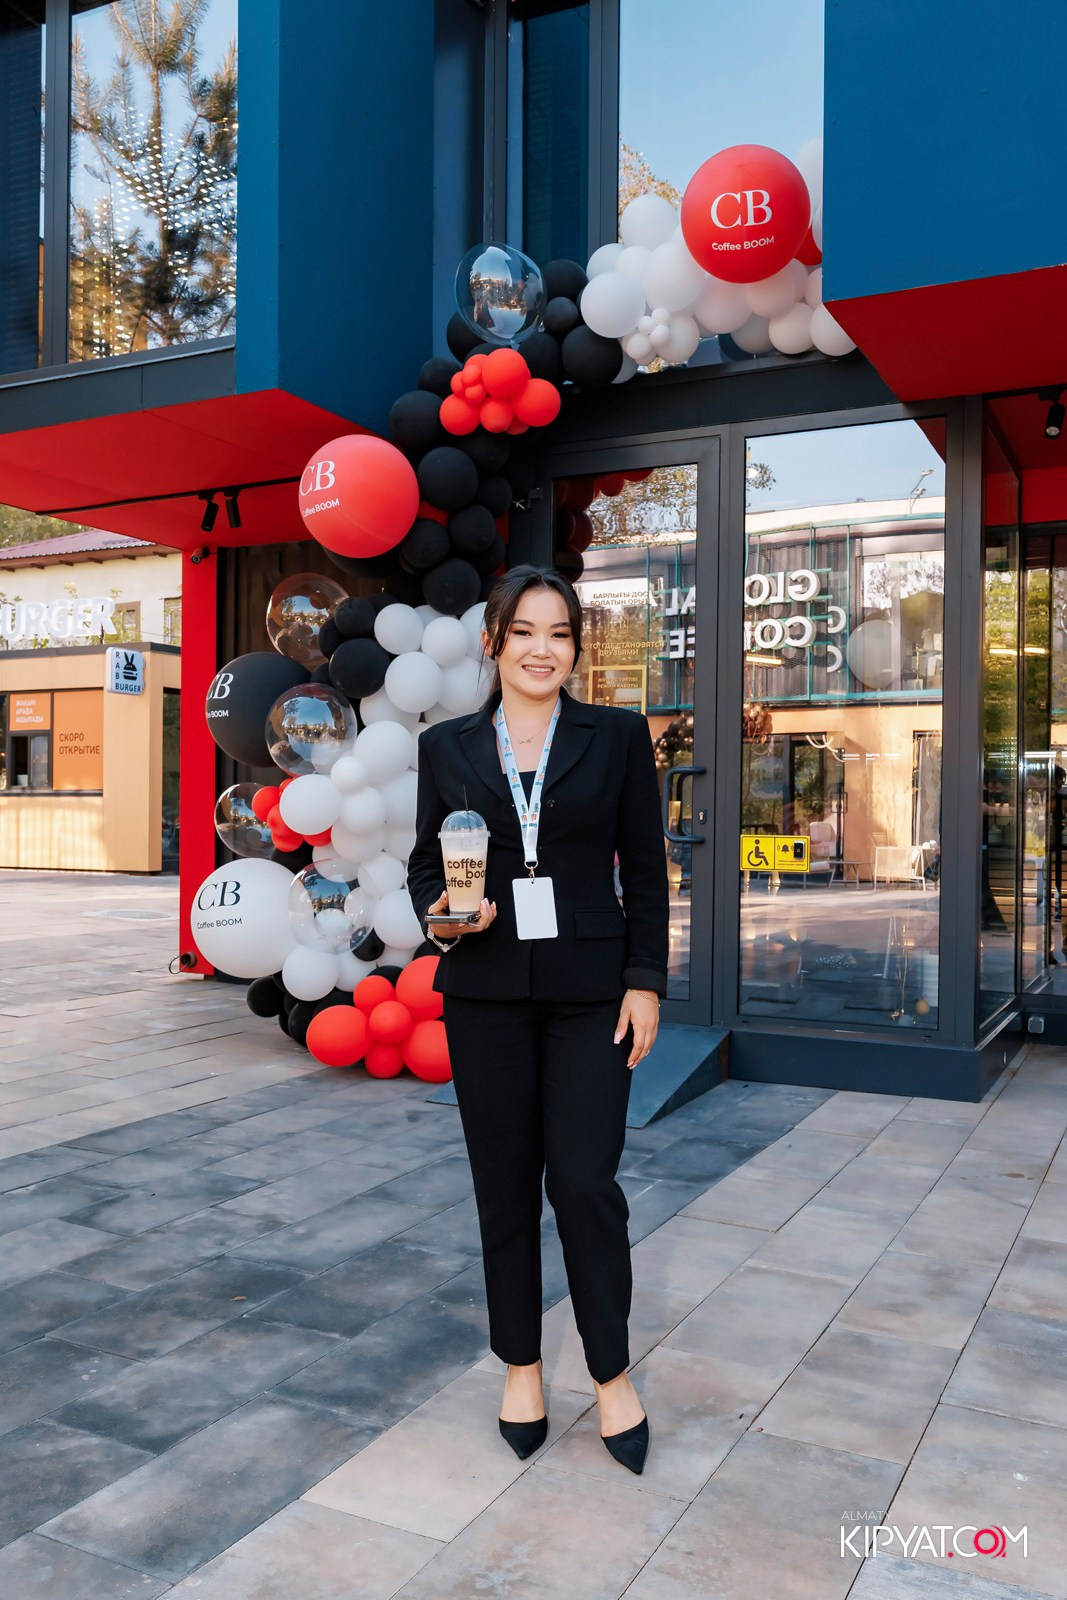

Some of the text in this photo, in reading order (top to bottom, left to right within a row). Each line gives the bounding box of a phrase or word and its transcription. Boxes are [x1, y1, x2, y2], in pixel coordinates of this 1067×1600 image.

[710, 189, 772, 229] CB
[711, 236, 775, 251] Coffee BOOM
[300, 460, 335, 496] CB
[315, 498, 340, 512] BOOM
[0, 597, 118, 641] URGER
[601, 642, 615, 650] ГДЕ
[600, 649, 639, 657] ДРУЗЬЯМИ
[115, 682, 142, 693] BURGER
[211, 709, 229, 718] BOOM
[59, 732, 84, 742] СКОРО
[59, 745, 100, 755] ОТКРЫТИЕ
[447, 858, 483, 869] coffee
[198, 880, 241, 911] CB
[197, 917, 242, 929] Coffee BOOM
